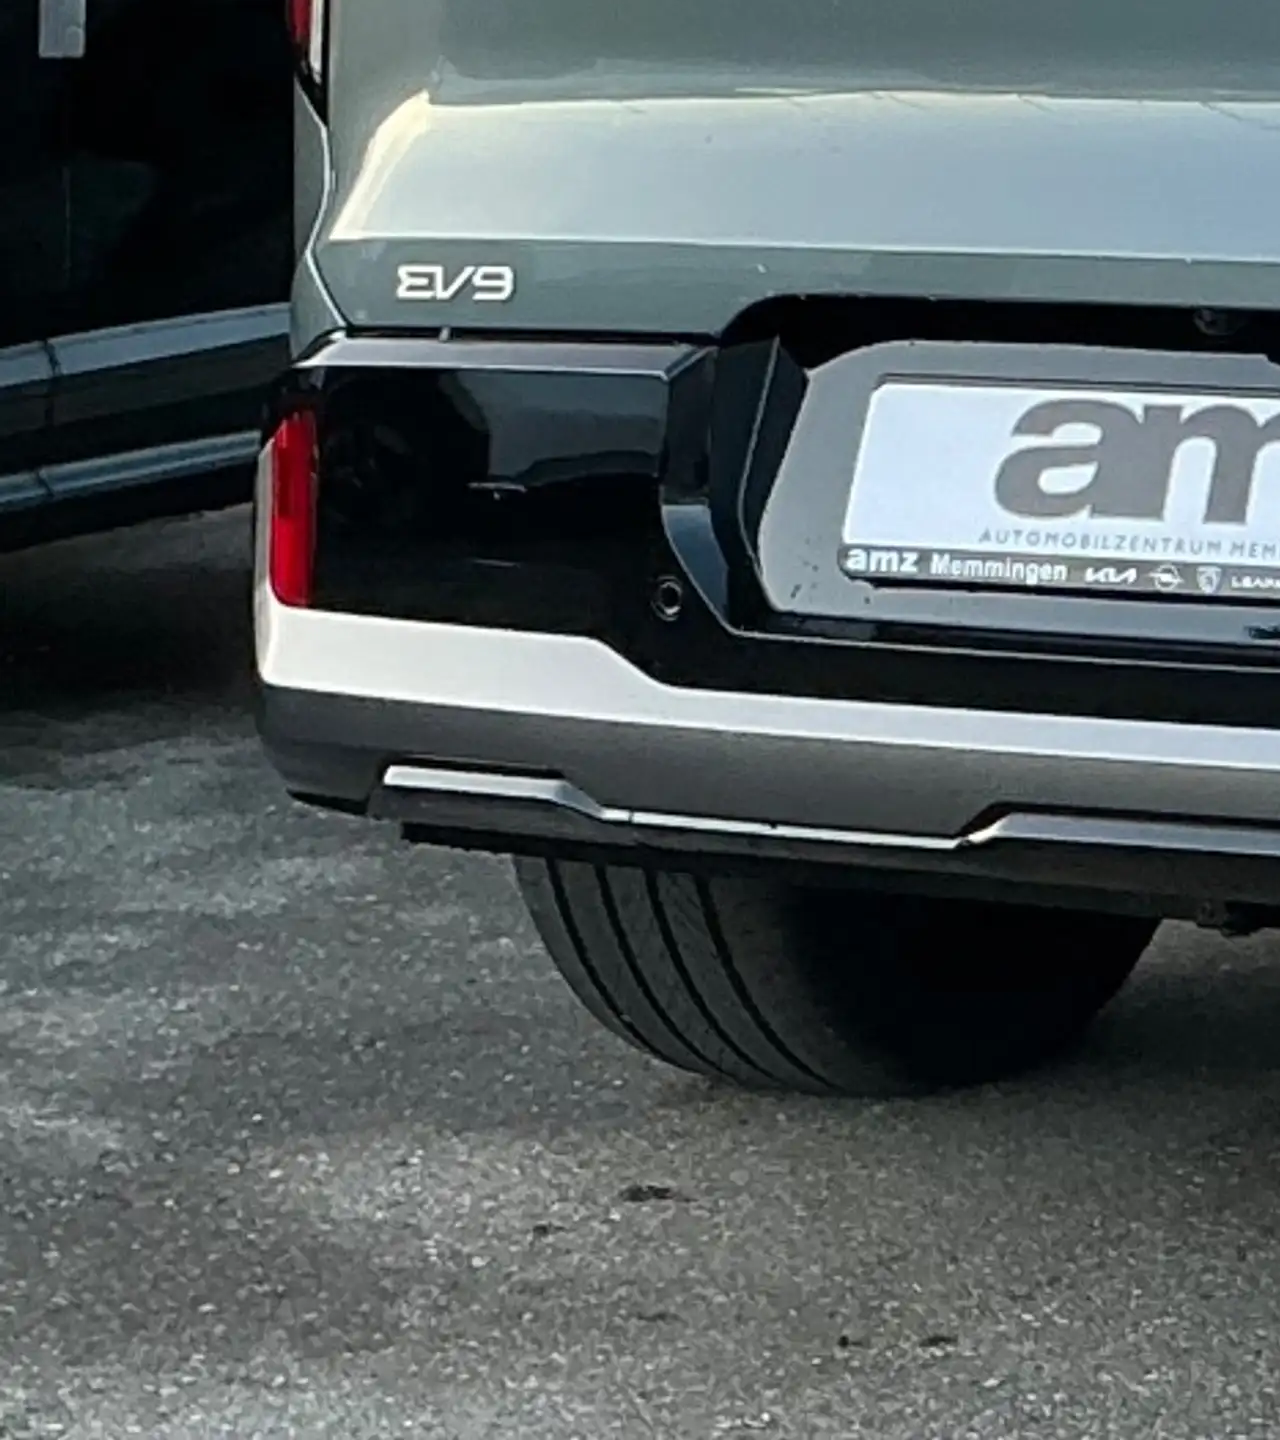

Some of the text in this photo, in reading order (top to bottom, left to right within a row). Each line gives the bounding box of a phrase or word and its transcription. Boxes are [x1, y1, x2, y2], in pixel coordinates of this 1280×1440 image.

[396, 264, 515, 301] EV9
[978, 527, 1222, 556] AUTOMOBILZENTRUM
[846, 548, 1068, 585] amz Memmingen
